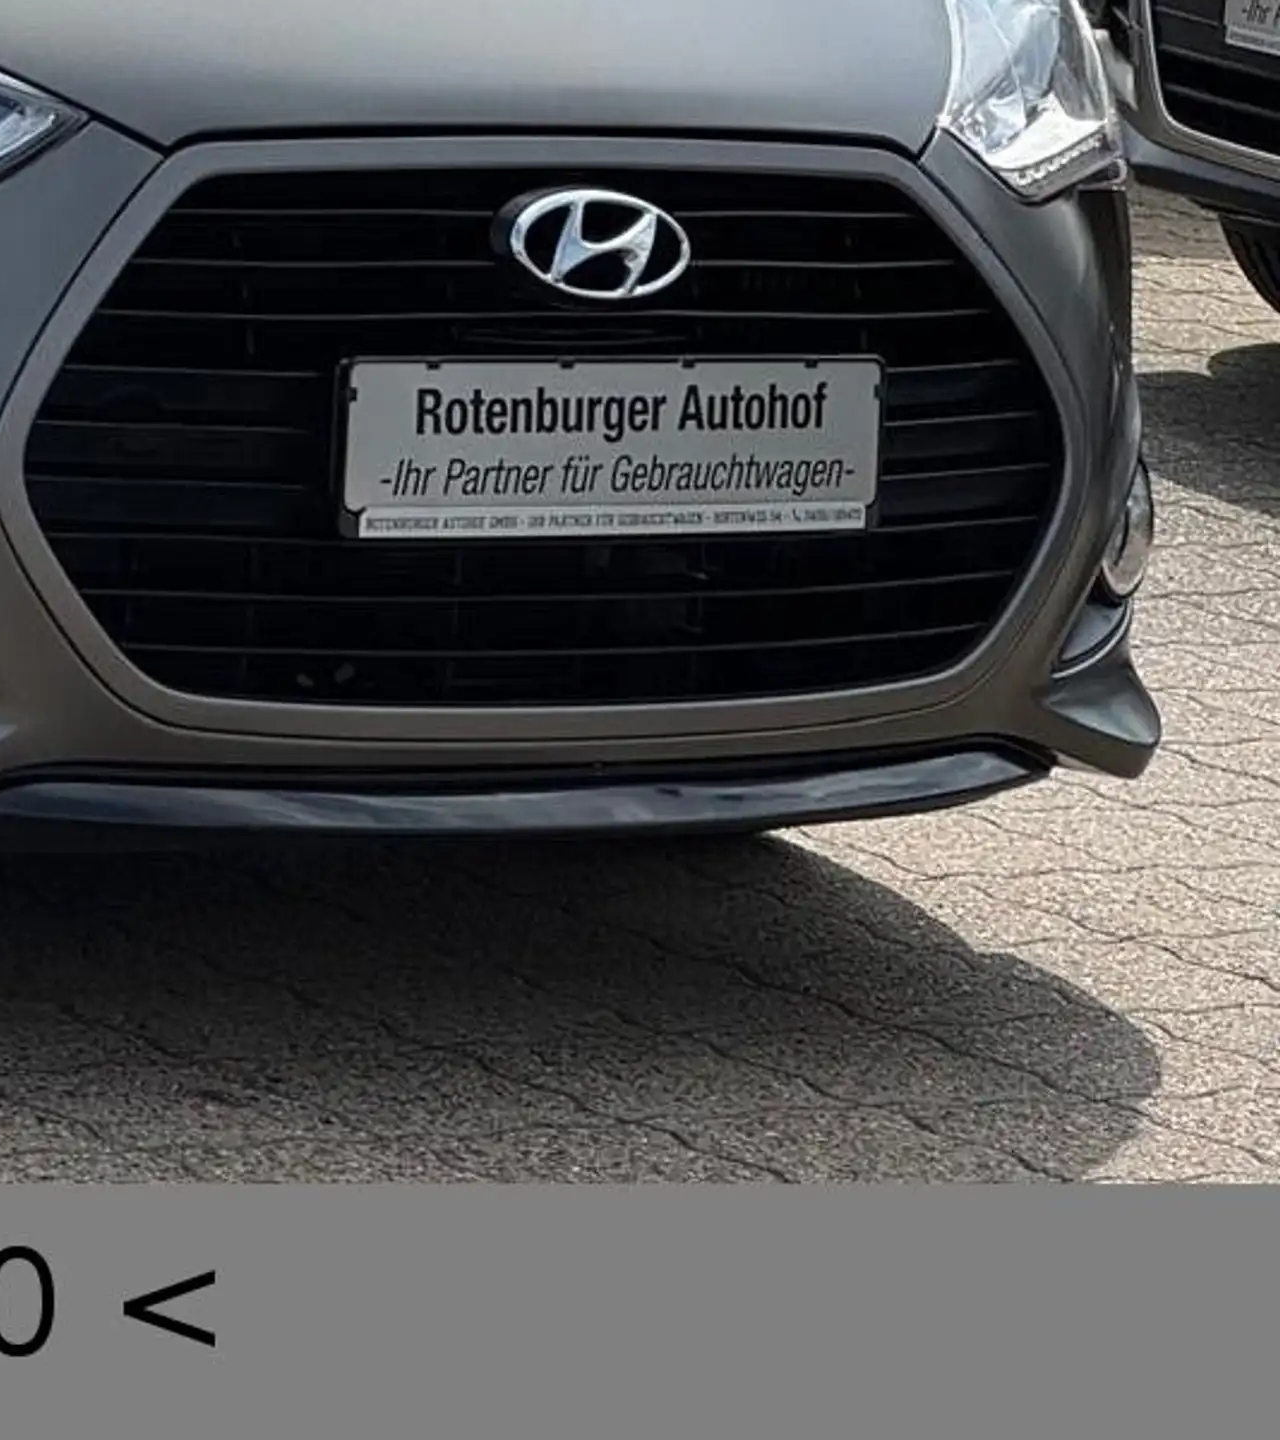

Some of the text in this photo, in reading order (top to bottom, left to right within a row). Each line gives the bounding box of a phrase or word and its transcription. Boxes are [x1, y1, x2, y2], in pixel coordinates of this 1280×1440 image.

[415, 380, 829, 444] Rotenburger Autohof
[379, 453, 856, 497] -Ihr Partner für Gebrauchtwagen-
